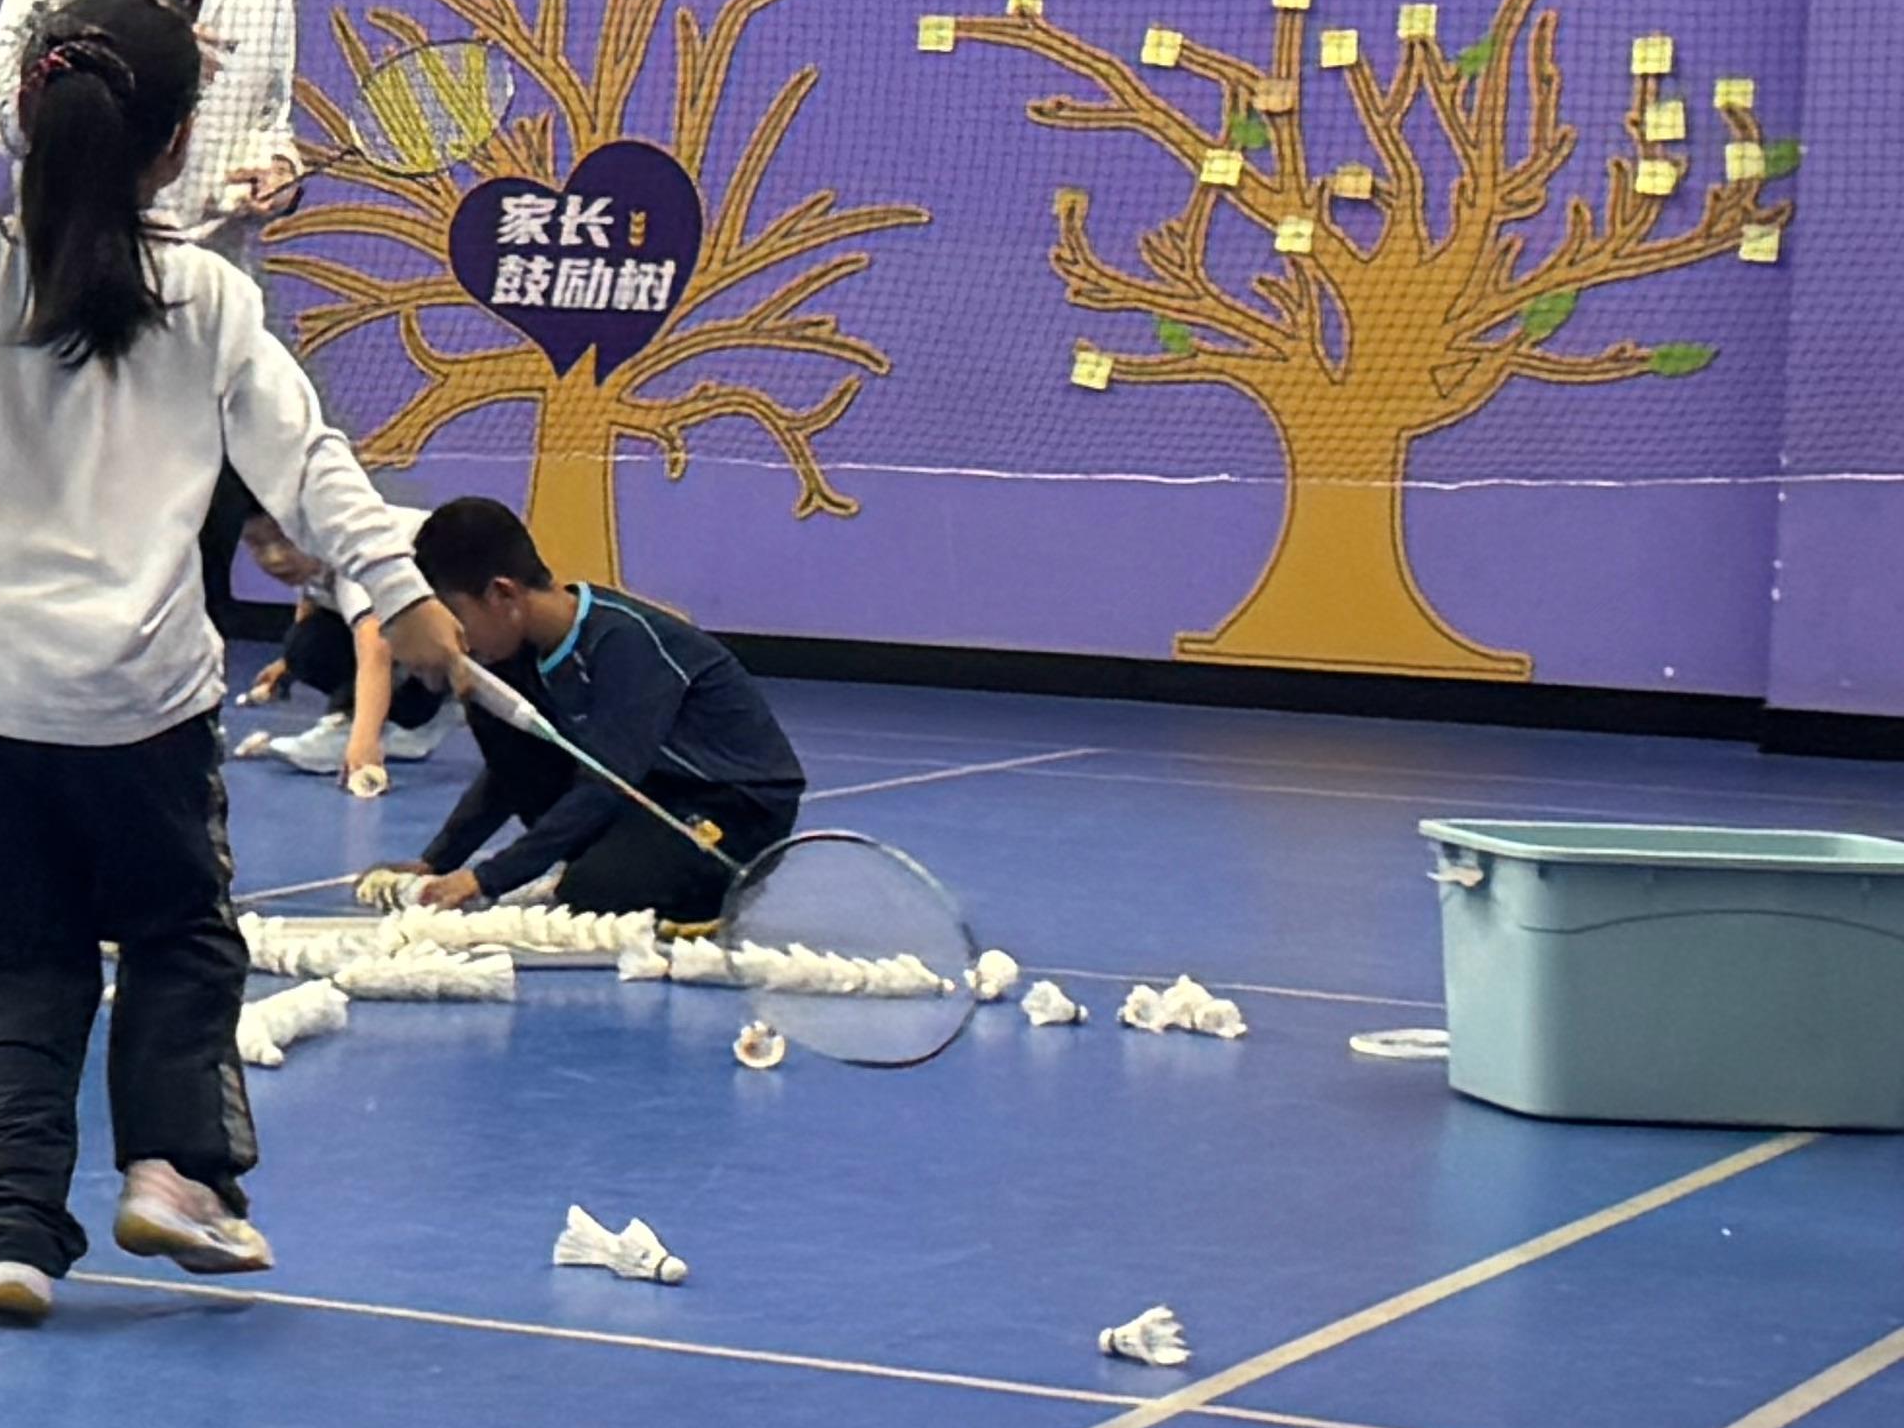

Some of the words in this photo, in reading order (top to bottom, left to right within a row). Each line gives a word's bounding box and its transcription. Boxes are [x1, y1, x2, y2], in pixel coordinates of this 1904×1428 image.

[497, 194, 614, 248] 家长
[492, 254, 676, 312] 鼓励树
